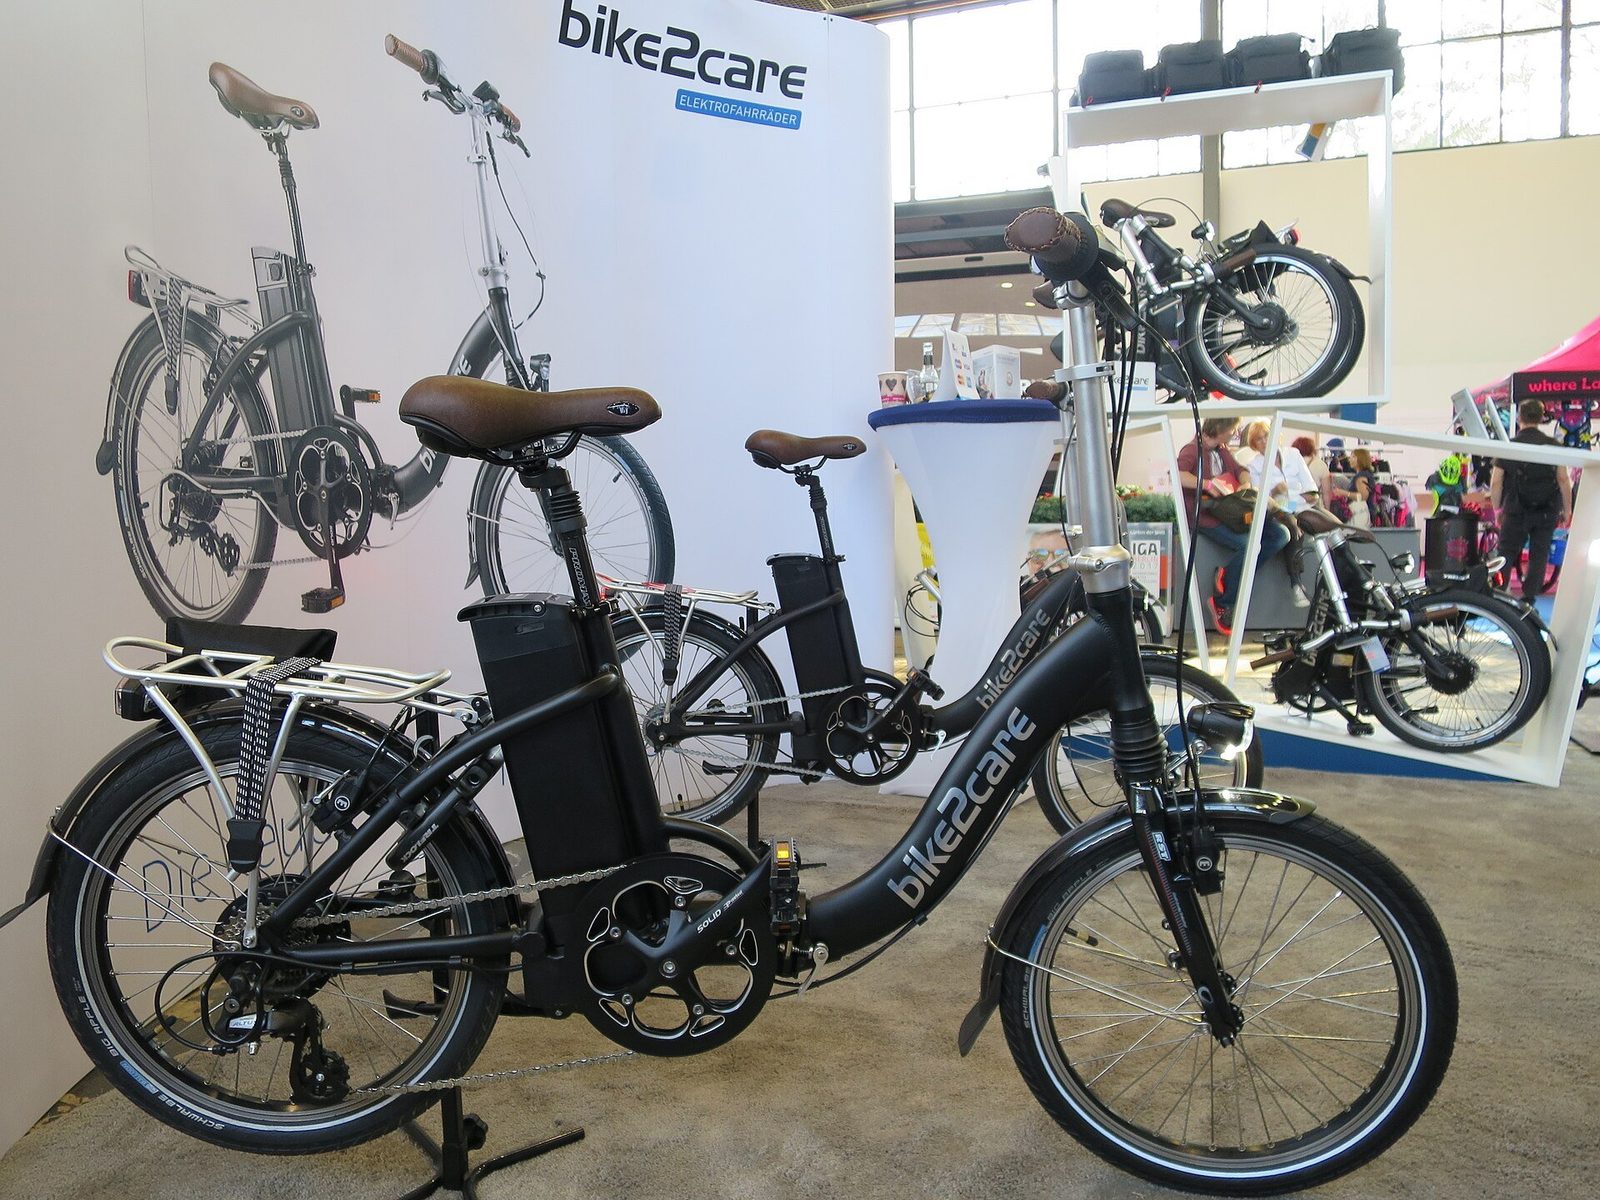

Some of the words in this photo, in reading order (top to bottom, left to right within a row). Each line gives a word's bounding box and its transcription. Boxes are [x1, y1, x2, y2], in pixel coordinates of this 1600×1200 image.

[558, 0, 808, 100] bike2care
[679, 94, 798, 126] ELEKTROFAHRRÄDER
[1528, 378, 1577, 393] where
[1132, 543, 1158, 555] IGA
[975, 608, 1051, 712] bike2care
[886, 706, 1037, 909] bike2care
[1153, 832, 1171, 861] RST
[696, 908, 722, 934] SOLID
[78, 995, 103, 1035] APPLE
[101, 1038, 119, 1057] BIG
[157, 1093, 225, 1131] SCHWALBE
